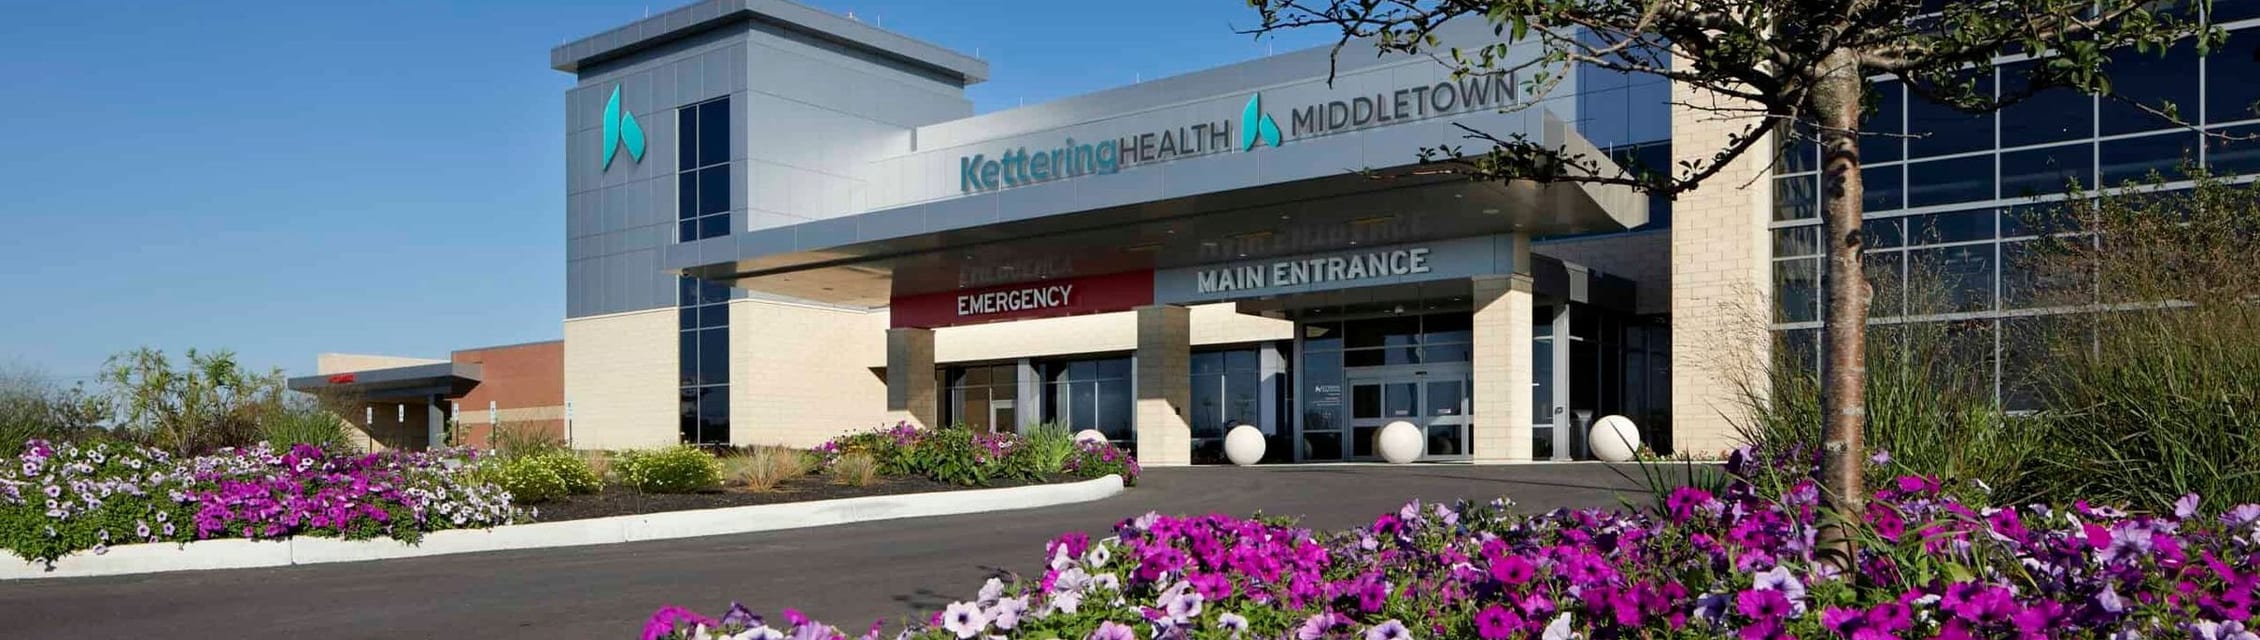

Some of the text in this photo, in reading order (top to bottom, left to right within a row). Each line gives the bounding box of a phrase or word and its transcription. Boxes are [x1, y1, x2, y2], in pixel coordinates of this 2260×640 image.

[1292, 71, 1519, 137] MIDDLETOWN
[1198, 248, 1430, 294] MAIN ENTRANCE
[957, 284, 1073, 316] EMERGENCY
